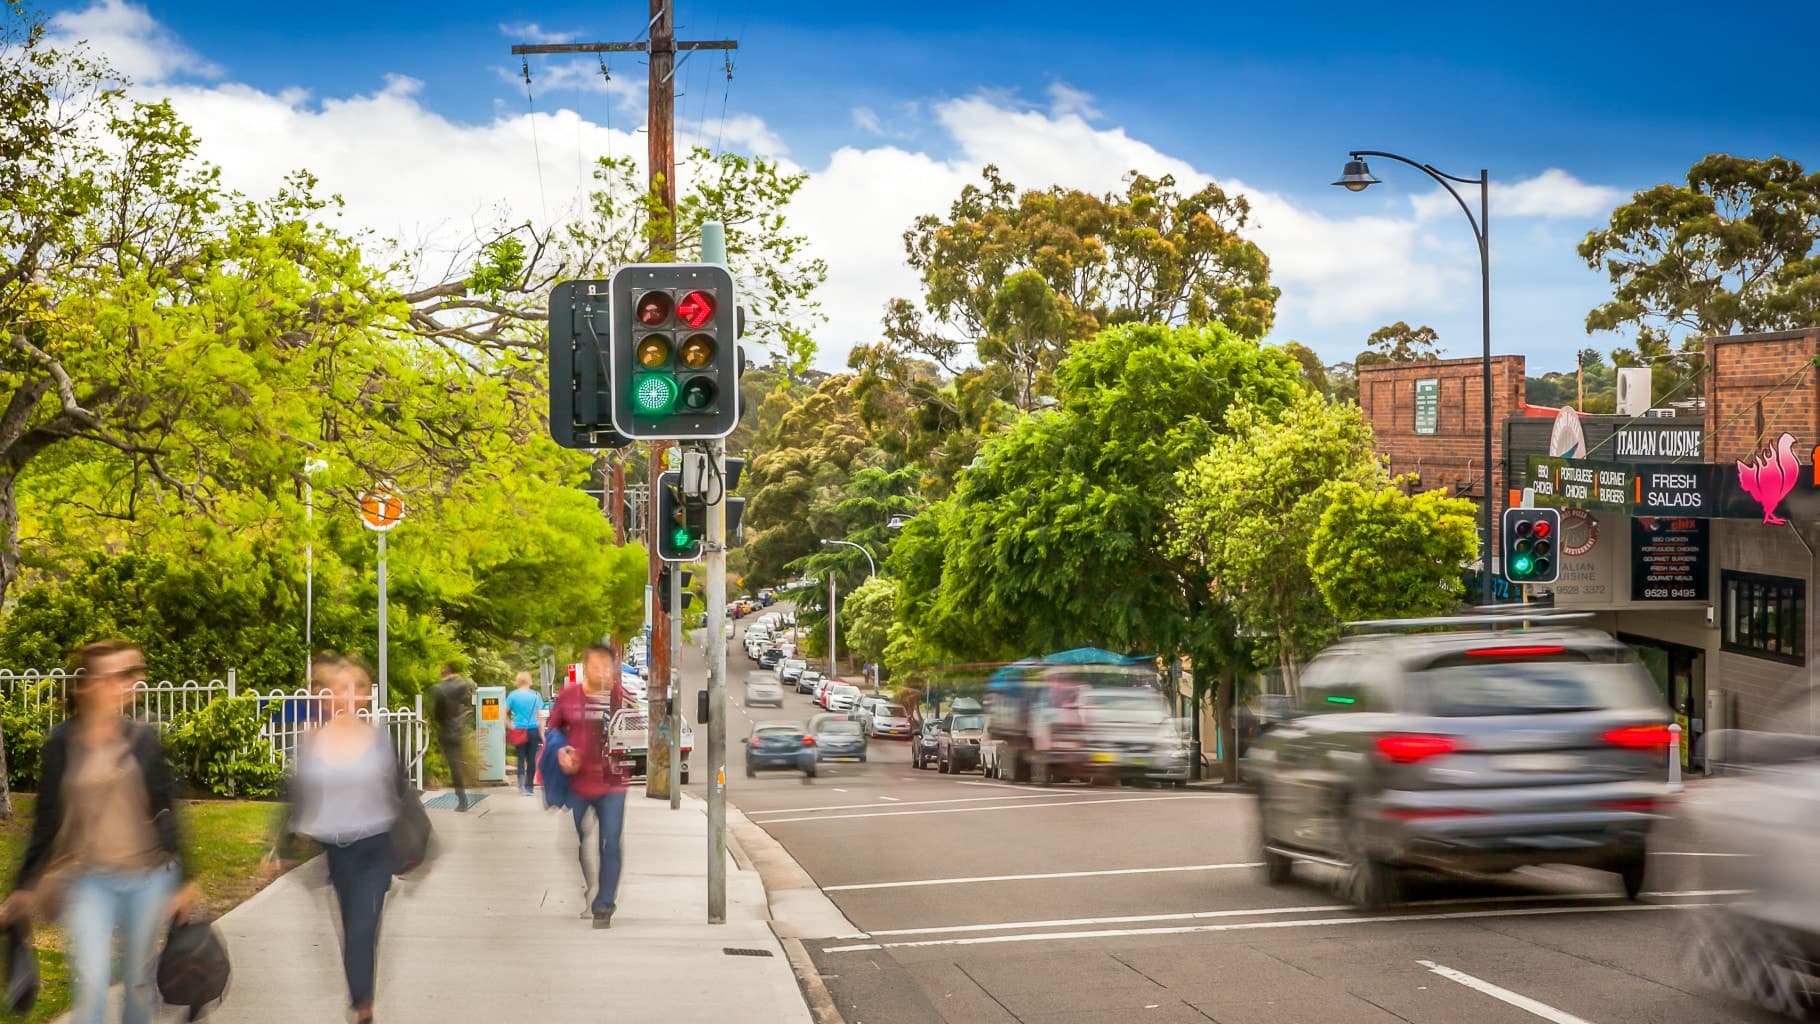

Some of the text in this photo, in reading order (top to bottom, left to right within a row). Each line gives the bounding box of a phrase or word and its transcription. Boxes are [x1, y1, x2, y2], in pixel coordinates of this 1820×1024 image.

[1617, 430, 1700, 457] ITALIAN CUISINE
[1537, 464, 1549, 479] BBQ
[1560, 467, 1593, 483] PORTUGUESE
[1599, 470, 1625, 486] GOURMET
[1532, 480, 1554, 495] CHICKEN
[1652, 474, 1697, 489] FRESH
[1565, 484, 1588, 499] CHICKEN
[1599, 488, 1625, 504] BURGERS
[1648, 492, 1702, 507] SALADS
[1561, 562, 1594, 571] ALIAN
[1559, 572, 1596, 580] UISINE
[1644, 588, 1668, 598] 9528
